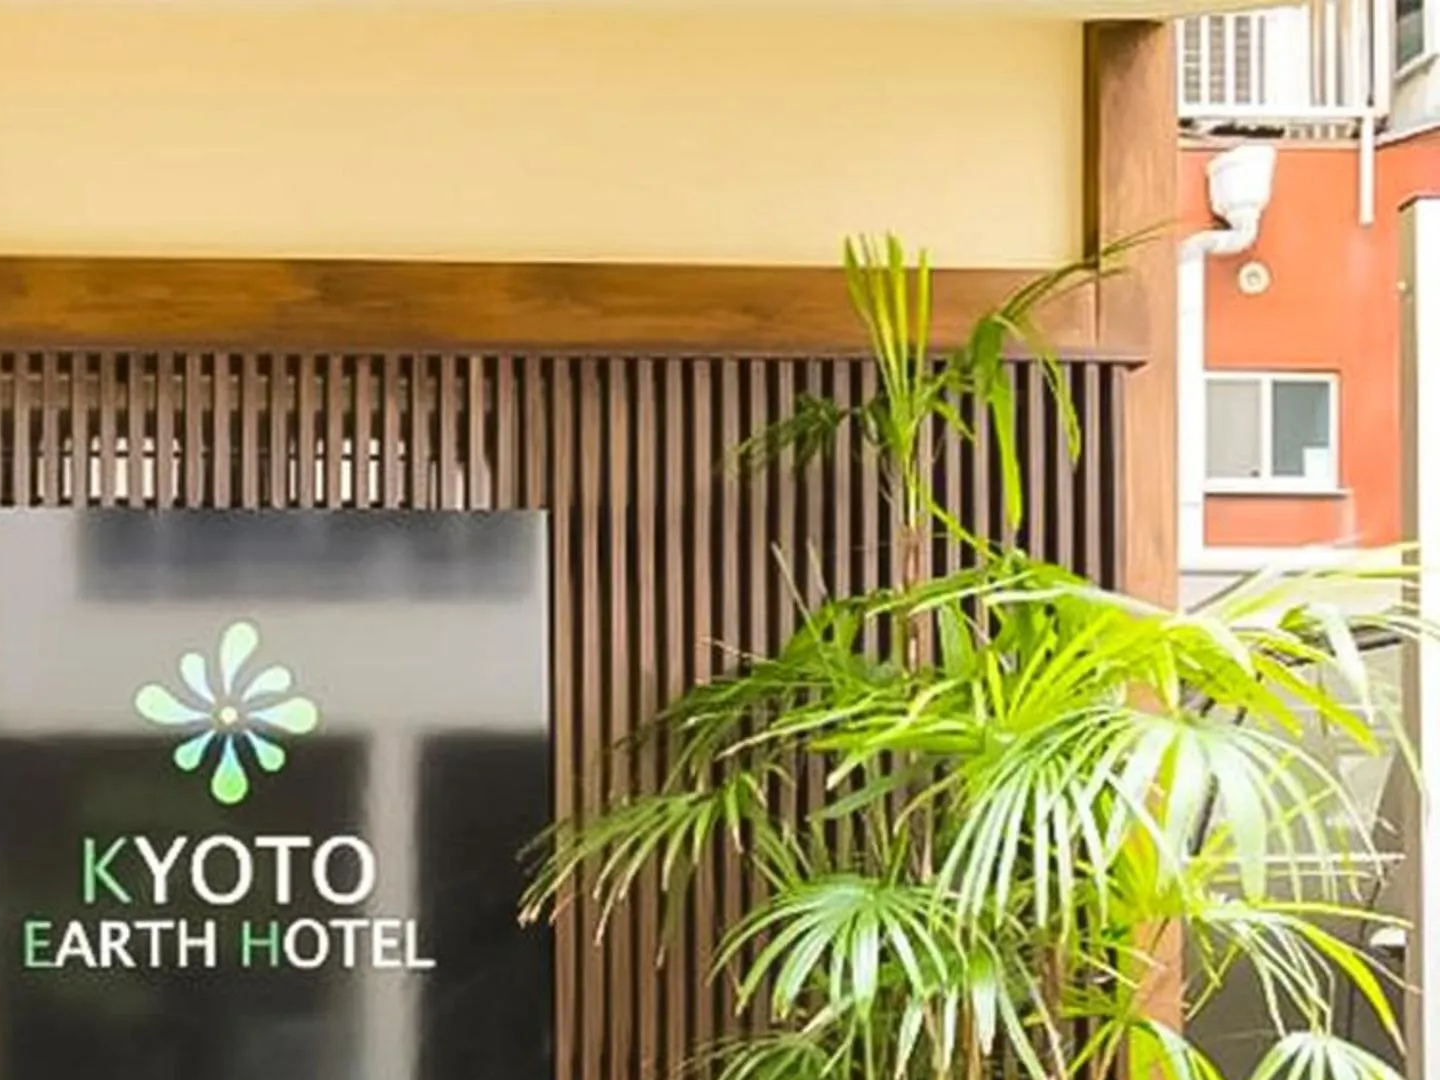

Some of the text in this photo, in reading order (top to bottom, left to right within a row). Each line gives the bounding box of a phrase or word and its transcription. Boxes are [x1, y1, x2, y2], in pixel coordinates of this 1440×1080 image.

[83, 835, 377, 905] KYOTO
[24, 918, 437, 969] EARTH HOTEL
